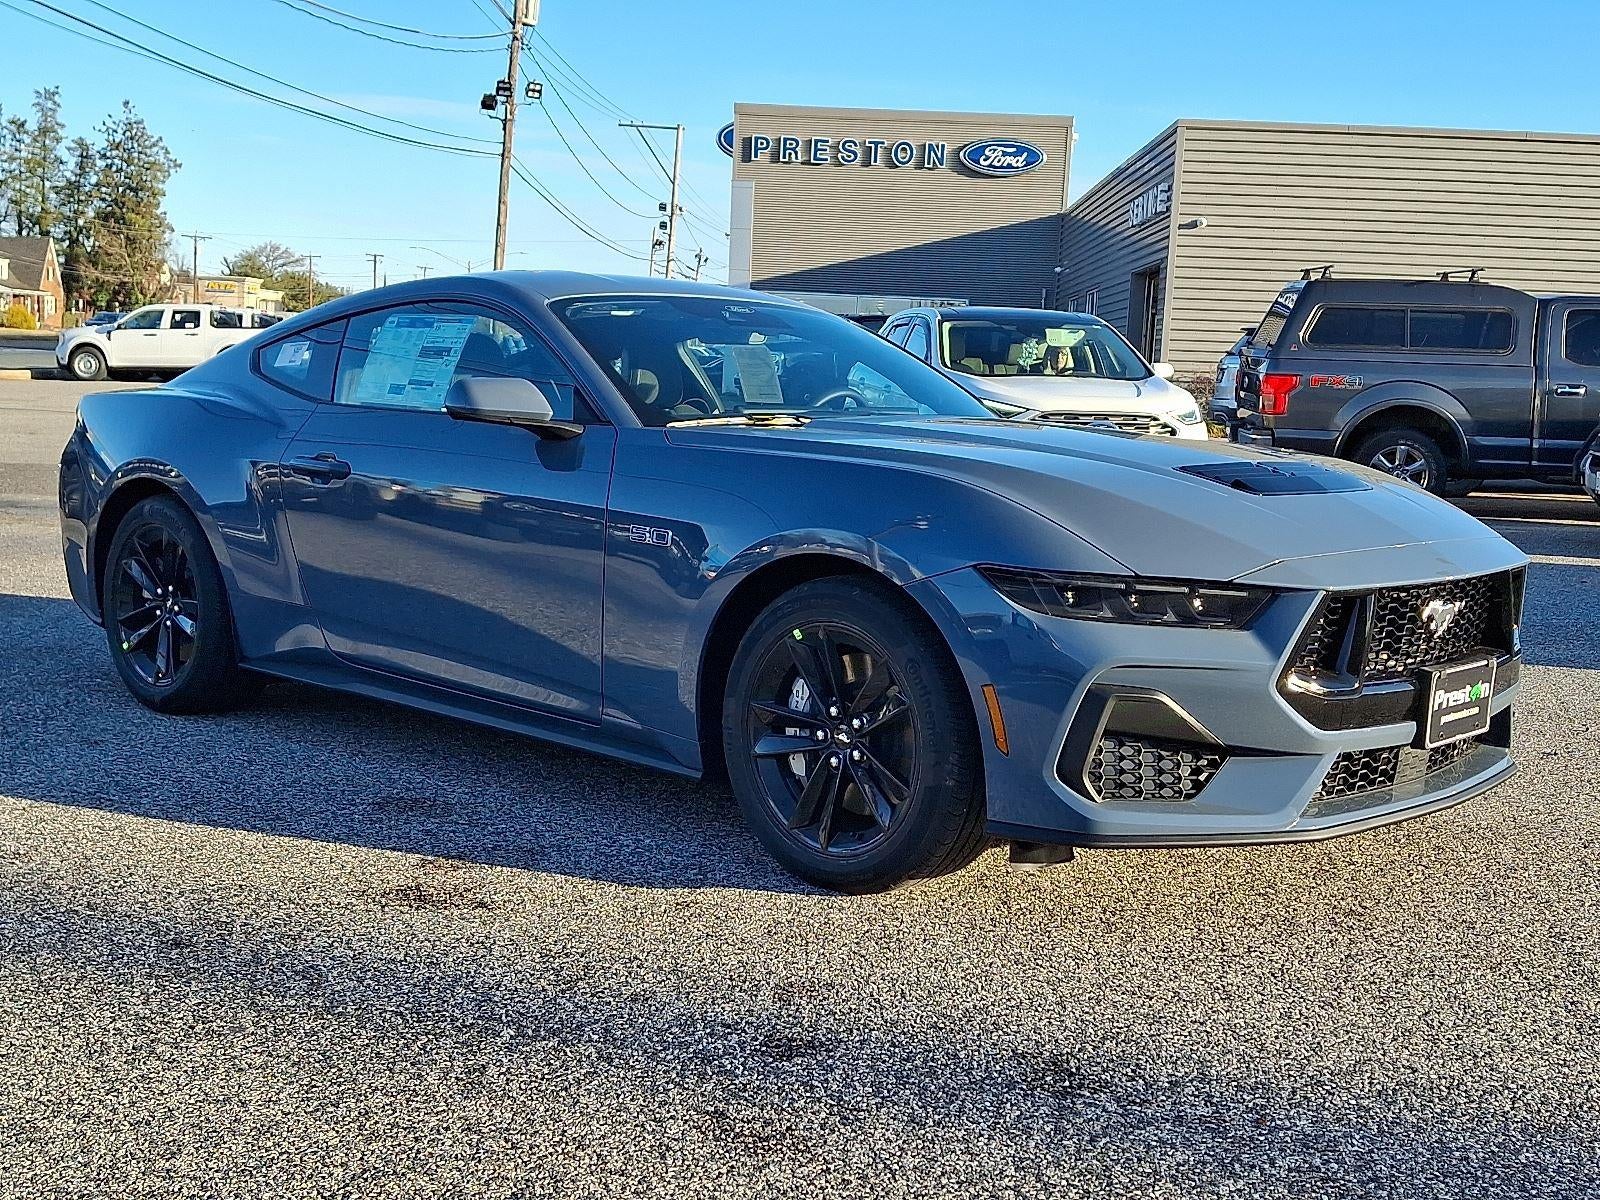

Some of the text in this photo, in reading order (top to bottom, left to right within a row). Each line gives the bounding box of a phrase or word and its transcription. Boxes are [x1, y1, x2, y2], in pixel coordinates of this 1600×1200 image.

[751, 135, 947, 168] PRESTON
[980, 145, 1028, 168] Ford
[1310, 374, 1363, 388] FX4
